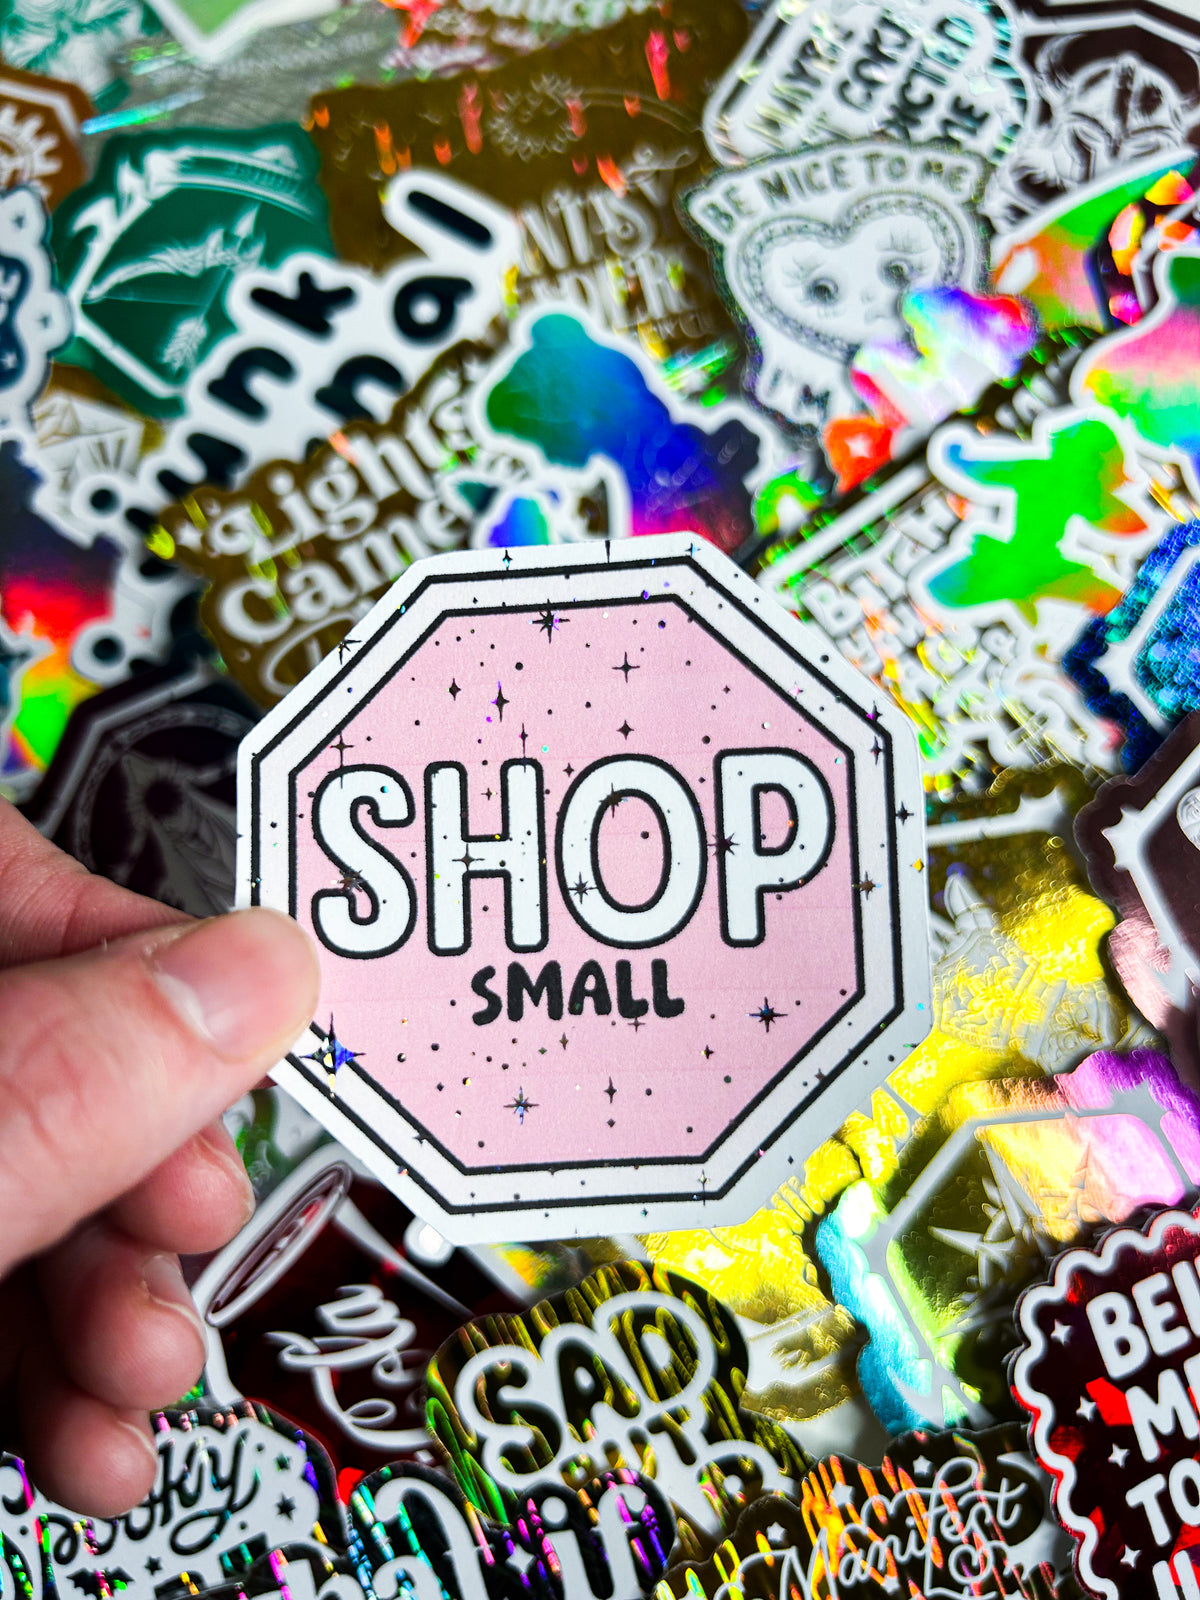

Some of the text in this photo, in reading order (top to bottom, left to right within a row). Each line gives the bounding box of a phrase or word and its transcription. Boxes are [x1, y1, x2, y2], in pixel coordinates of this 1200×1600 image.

[701, 150, 972, 234] BE NICE TO ME
[220, 465, 510, 643] Came
[311, 748, 837, 960] SHOP
[471, 958, 686, 1026] SMALL
[473, 1303, 701, 1478] SAD
[1086, 1258, 1200, 1381] BEI
